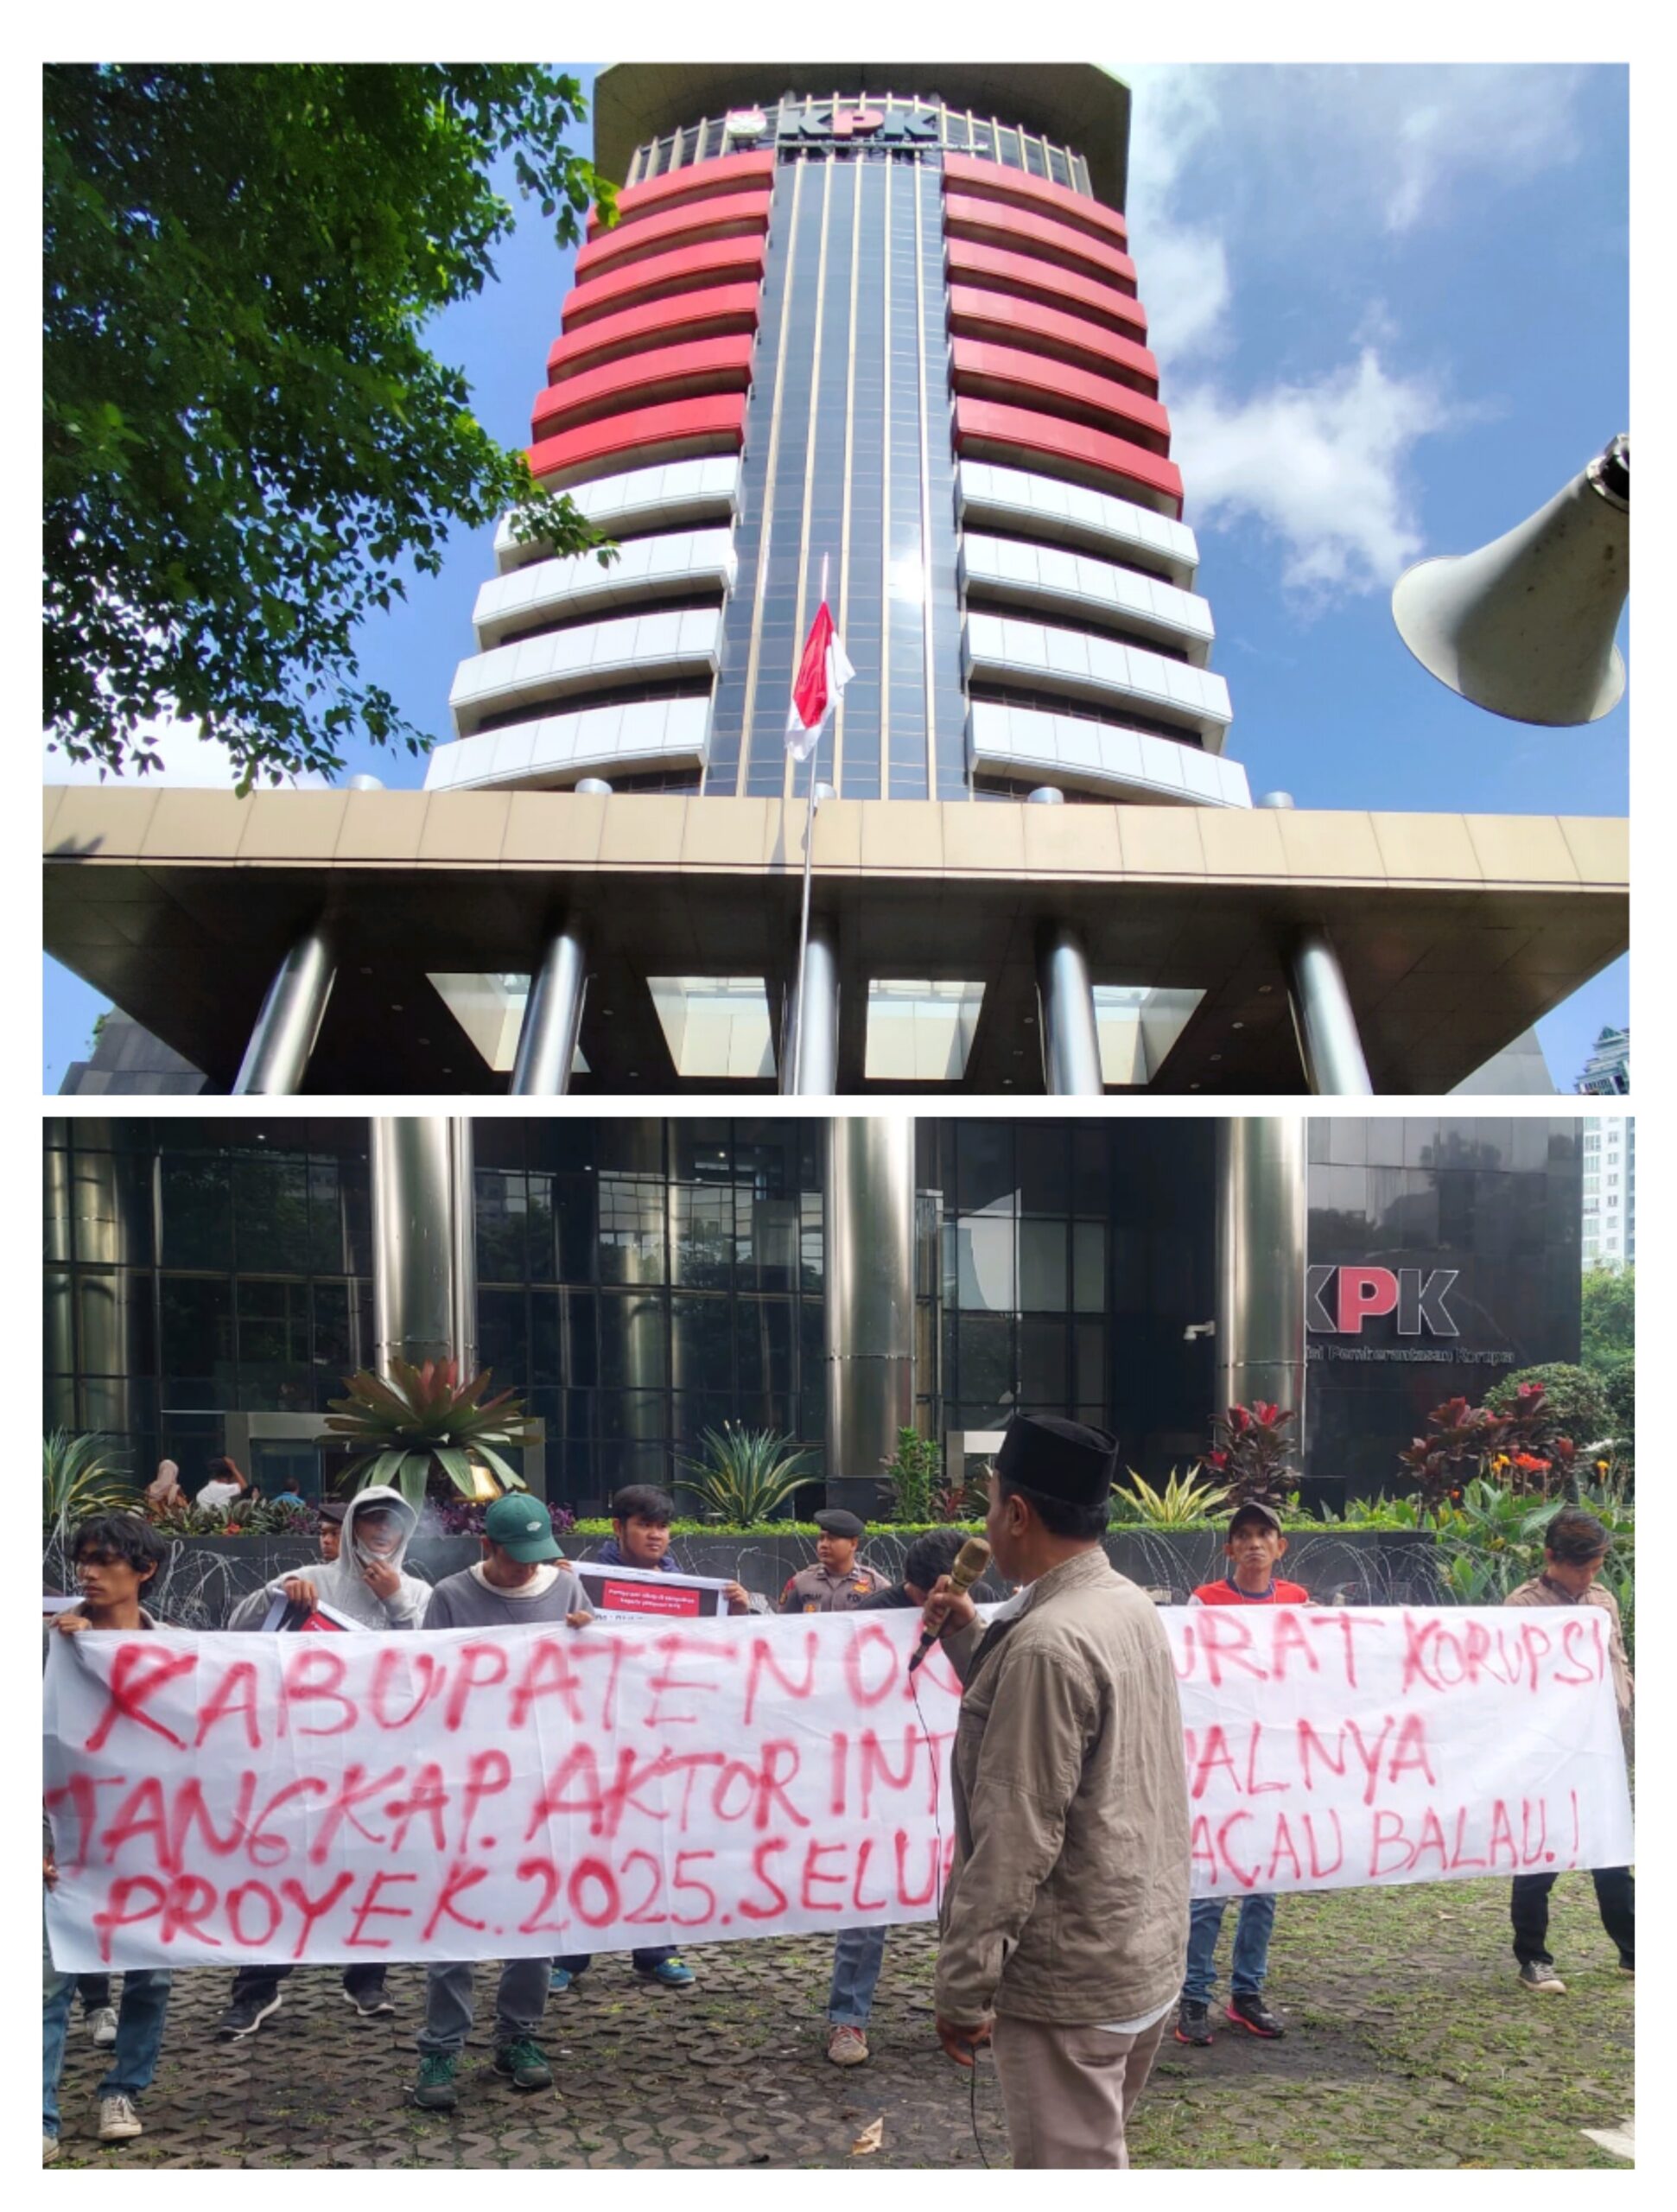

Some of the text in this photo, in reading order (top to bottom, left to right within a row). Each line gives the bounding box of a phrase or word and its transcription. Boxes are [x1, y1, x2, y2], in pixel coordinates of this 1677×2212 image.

[779, 110, 939, 141] KPK
[85, 1609, 1605, 1751] KABUPATEN OK URAT KORUPSI
[522, 1739, 812, 1840] AKTOR
[829, 1722, 956, 1820] INT
[1180, 1713, 1437, 1806] ALNYA
[737, 1827, 958, 1922] SELU
